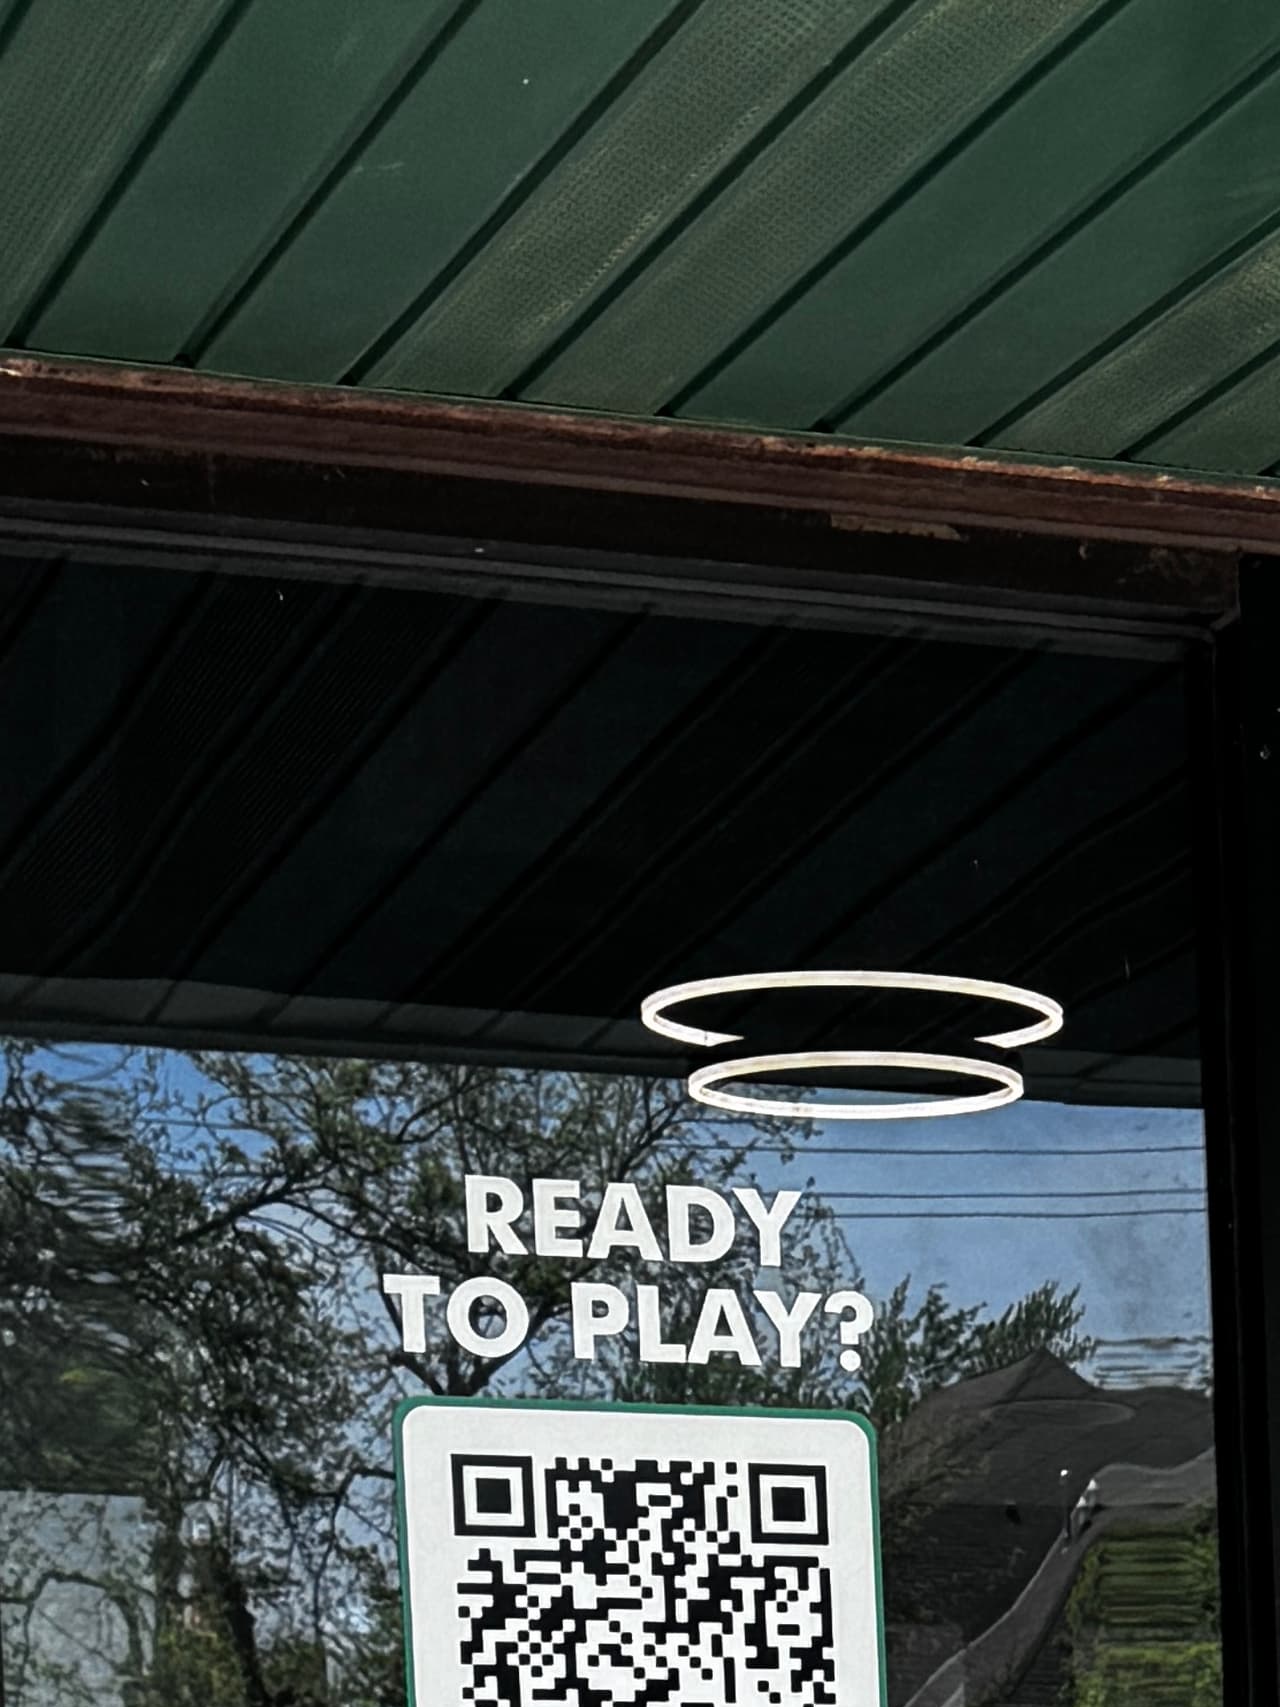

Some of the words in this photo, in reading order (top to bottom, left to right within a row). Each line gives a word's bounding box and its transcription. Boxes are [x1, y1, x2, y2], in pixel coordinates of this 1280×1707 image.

[464, 1174, 803, 1267] READY
[382, 1273, 530, 1358] TO
[570, 1281, 875, 1374] PLAY?
